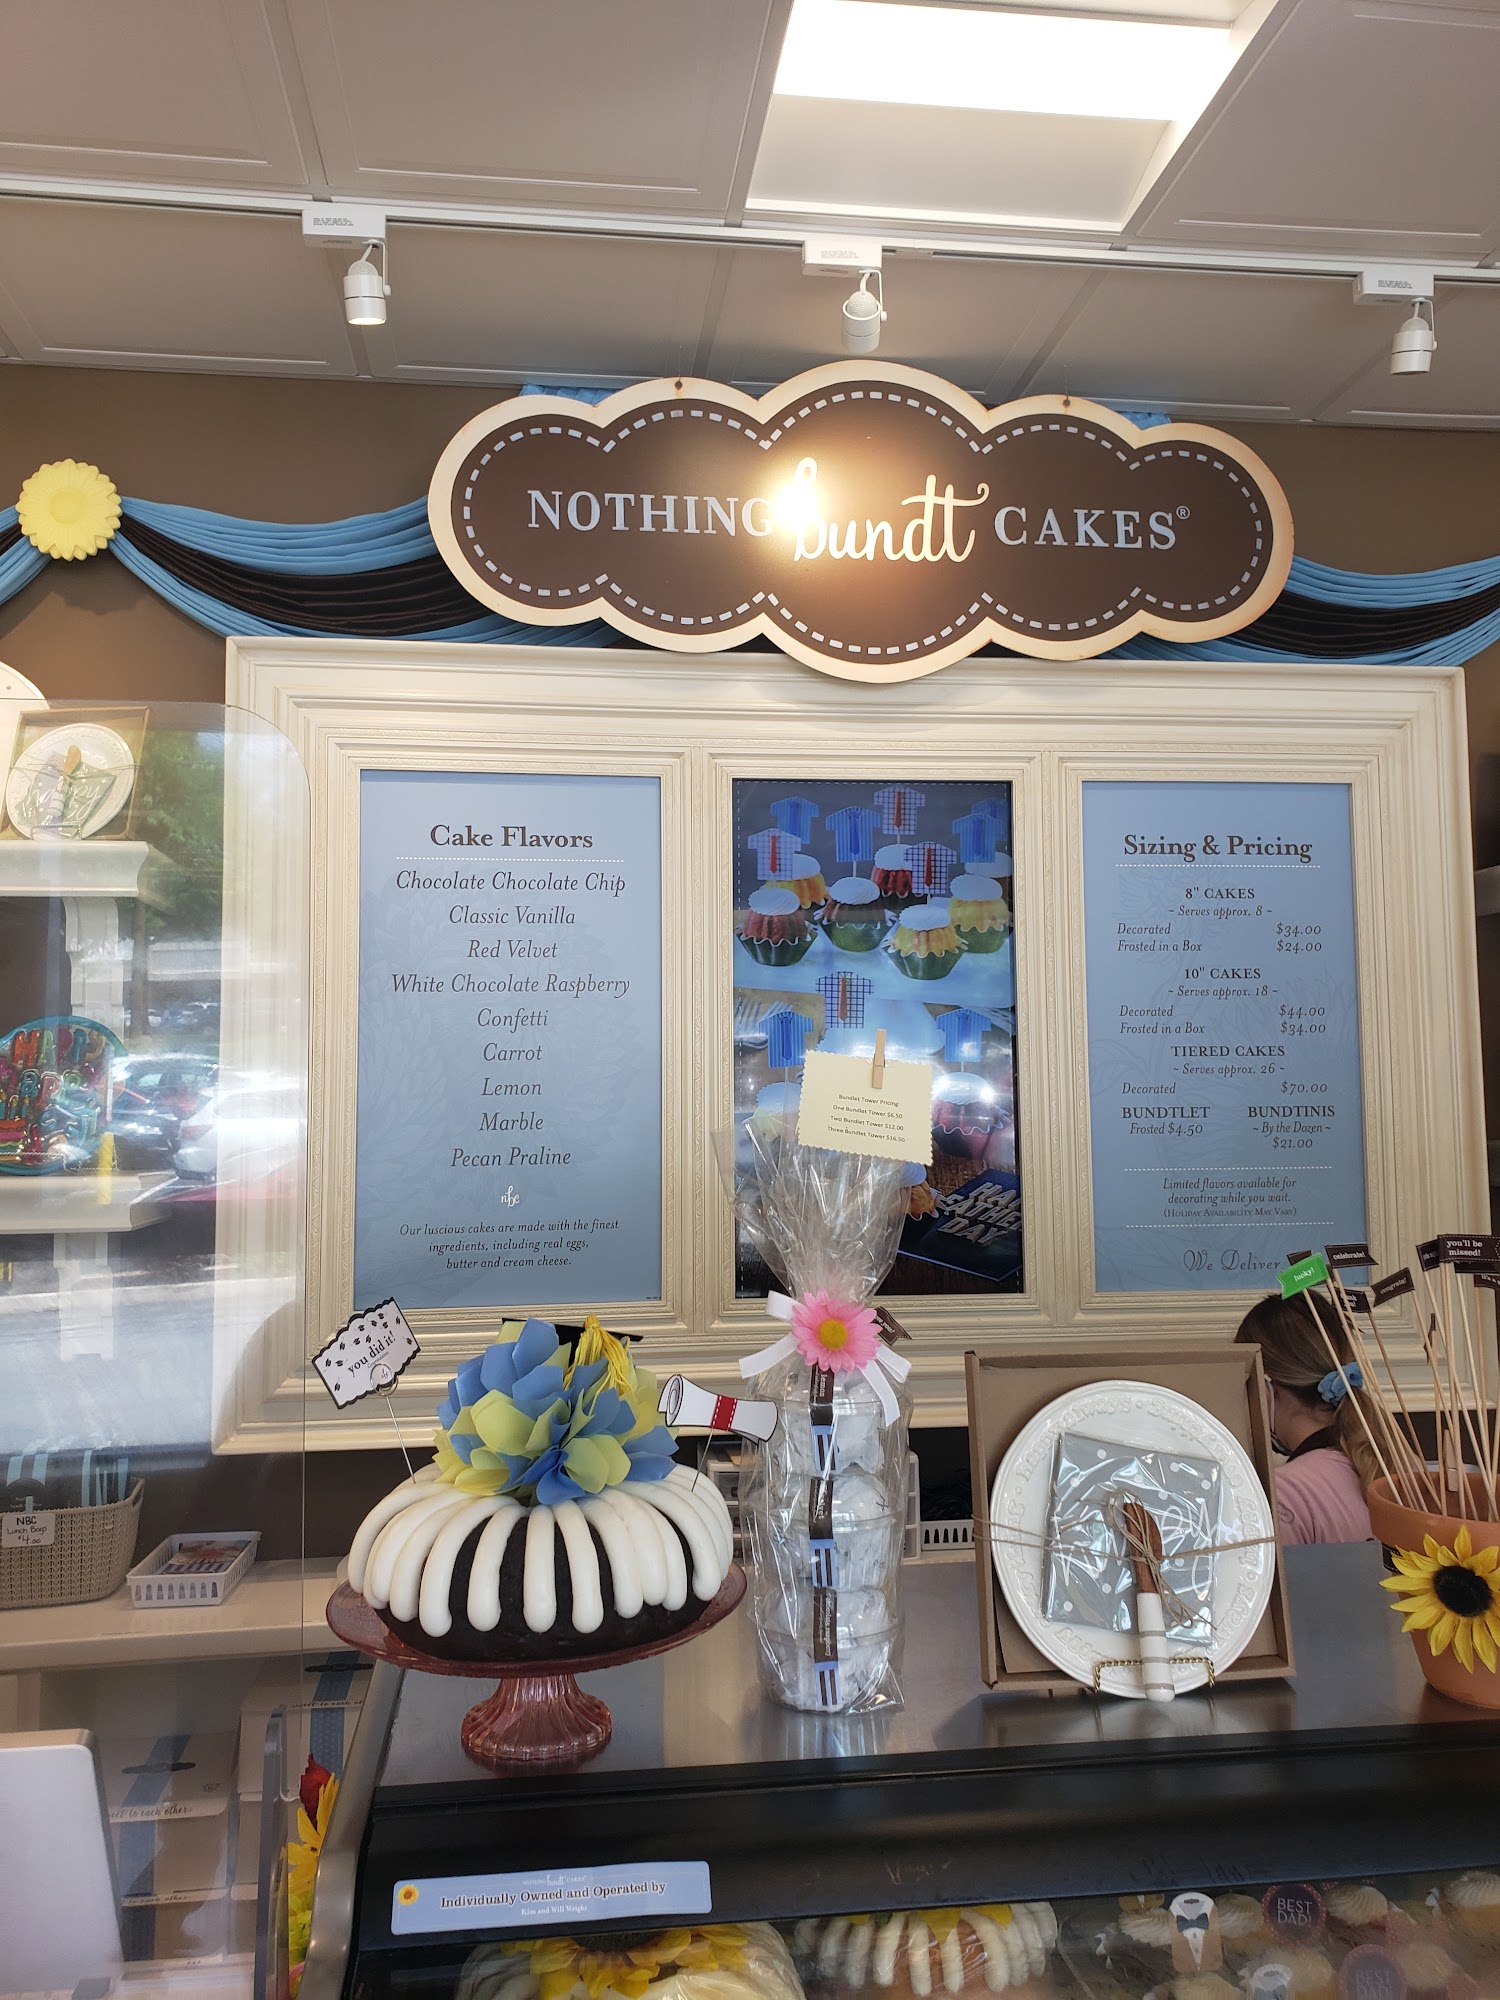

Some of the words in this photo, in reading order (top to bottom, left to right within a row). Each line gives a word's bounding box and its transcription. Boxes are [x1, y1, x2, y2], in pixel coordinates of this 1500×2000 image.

[527, 489, 774, 537] NOTHING
[792, 456, 990, 564] bundt
[430, 824, 494, 847] Cake
[501, 825, 593, 849] Flavors
[1124, 834, 1197, 863] Sizing
[1202, 834, 1221, 856] &
[1227, 835, 1313, 864] Pricing
[396, 869, 486, 890] Chocolate
[492, 870, 579, 891] Chocolate
[585, 872, 626, 898] Chip
[1204, 888, 1256, 900] CAKES
[449, 905, 509, 925] Classic
[515, 905, 576, 925] Vanilla
[1177, 905, 1211, 917] Serves
[1213, 906, 1251, 919] approx.
[1255, 904, 1263, 917] 8
[1117, 922, 1171, 935] Decorated
[1275, 922, 1322, 937] $34.00
[467, 938, 501, 958] Red
[507, 939, 558, 958] Velvet
[1117, 939, 1156, 952] Frosted
[1158, 941, 1170, 952] in
[1172, 943, 1179, 952] a
[1182, 940, 1203, 952] Box
[1275, 939, 1322, 954] $24.00
[1210, 967, 1262, 980] CAKES
[391, 973, 444, 993] White
[451, 973, 539, 993] Chocolate
[544, 973, 631, 999] Raspberry
[1177, 985, 1210, 997] Serves
[1212, 986, 1251, 999] approx.
[1255, 984, 1269, 997] 18
[1119, 1004, 1174, 1018] Decorated
[1278, 1004, 1326, 1019] $44.00
[477, 1007, 549, 1033] Confetti
[1119, 1021, 1159, 1035] Frosted
[1160, 1023, 1172, 1034] in
[1174, 1025, 1182, 1034] a
[1184, 1022, 1205, 1035] Box
[1279, 1021, 1327, 1037] $34.00
[483, 1042, 543, 1062] Carrot
[1170, 1045, 1230, 1057] TIERED
[1234, 1045, 1286, 1057] CAKES
[1182, 1062, 1216, 1075] Serves
[1217, 1063, 1256, 1078] approx.
[1260, 1063, 1276, 1075] 26
[481, 1077, 542, 1096] Lemon
[1121, 1082, 1176, 1095] Decorated
[1280, 1080, 1328, 1096] $70.00
[1121, 1106, 1211, 1119] BUNDTLET
[1247, 1105, 1336, 1119] BUNDTINIS
[479, 1110, 544, 1131] Marble
[1129, 1122, 1165, 1136] Frosted
[1167, 1121, 1204, 1138] $4.50
[1261, 1121, 1274, 1137] By
[1276, 1122, 1291, 1134] the
[1293, 1121, 1324, 1136] Dozen
[1271, 1138, 1313, 1150] $21.00
[450, 1148, 502, 1167] Pecan
[507, 1146, 571, 1166] Praline
[1163, 1178, 1200, 1191] Limited
[1200, 1177, 1235, 1192] flavors
[1236, 1176, 1280, 1189] available
[1281, 1176, 1297, 1191] for
[1168, 1192, 1218, 1206] decorating
[1219, 1192, 1246, 1203] while
[1244, 1194, 1265, 1207] you
[1267, 1191, 1291, 1203] wait.
[399, 1224, 422, 1236] Our
[424, 1222, 465, 1235] luscious
[468, 1222, 495, 1234] cakes
[498, 1223, 514, 1233] are
[518, 1220, 545, 1232] made
[548, 1219, 570, 1231] with
[573, 1219, 589, 1230] the
[589, 1218, 619, 1234] finest
[428, 1241, 488, 1256] ingredients,
[492, 1238, 541, 1253] including
[543, 1238, 563, 1249] real
[566, 1239, 590, 1252] eggs,
[1446, 1239, 1472, 1249] you'll
[1472, 1240, 1483, 1248] be
[446, 1258, 478, 1270] butter
[481, 1257, 500, 1269] and
[503, 1257, 535, 1268] cream
[537, 1256, 572, 1267] cheese.
[1183, 1249, 1213, 1271] We
[1221, 1249, 1282, 1271] Deliver
[348, 1355, 369, 1378] you
[369, 1339, 386, 1359] did
[16, 1515, 37, 1526] NBC
[441, 1889, 517, 1908] Individually
[520, 1888, 564, 1903] Owned
[566, 1885, 590, 1899] and
[593, 1882, 649, 1900] Operated
[651, 1881, 667, 1895] by
[1276, 1898, 1313, 1916] BEST
